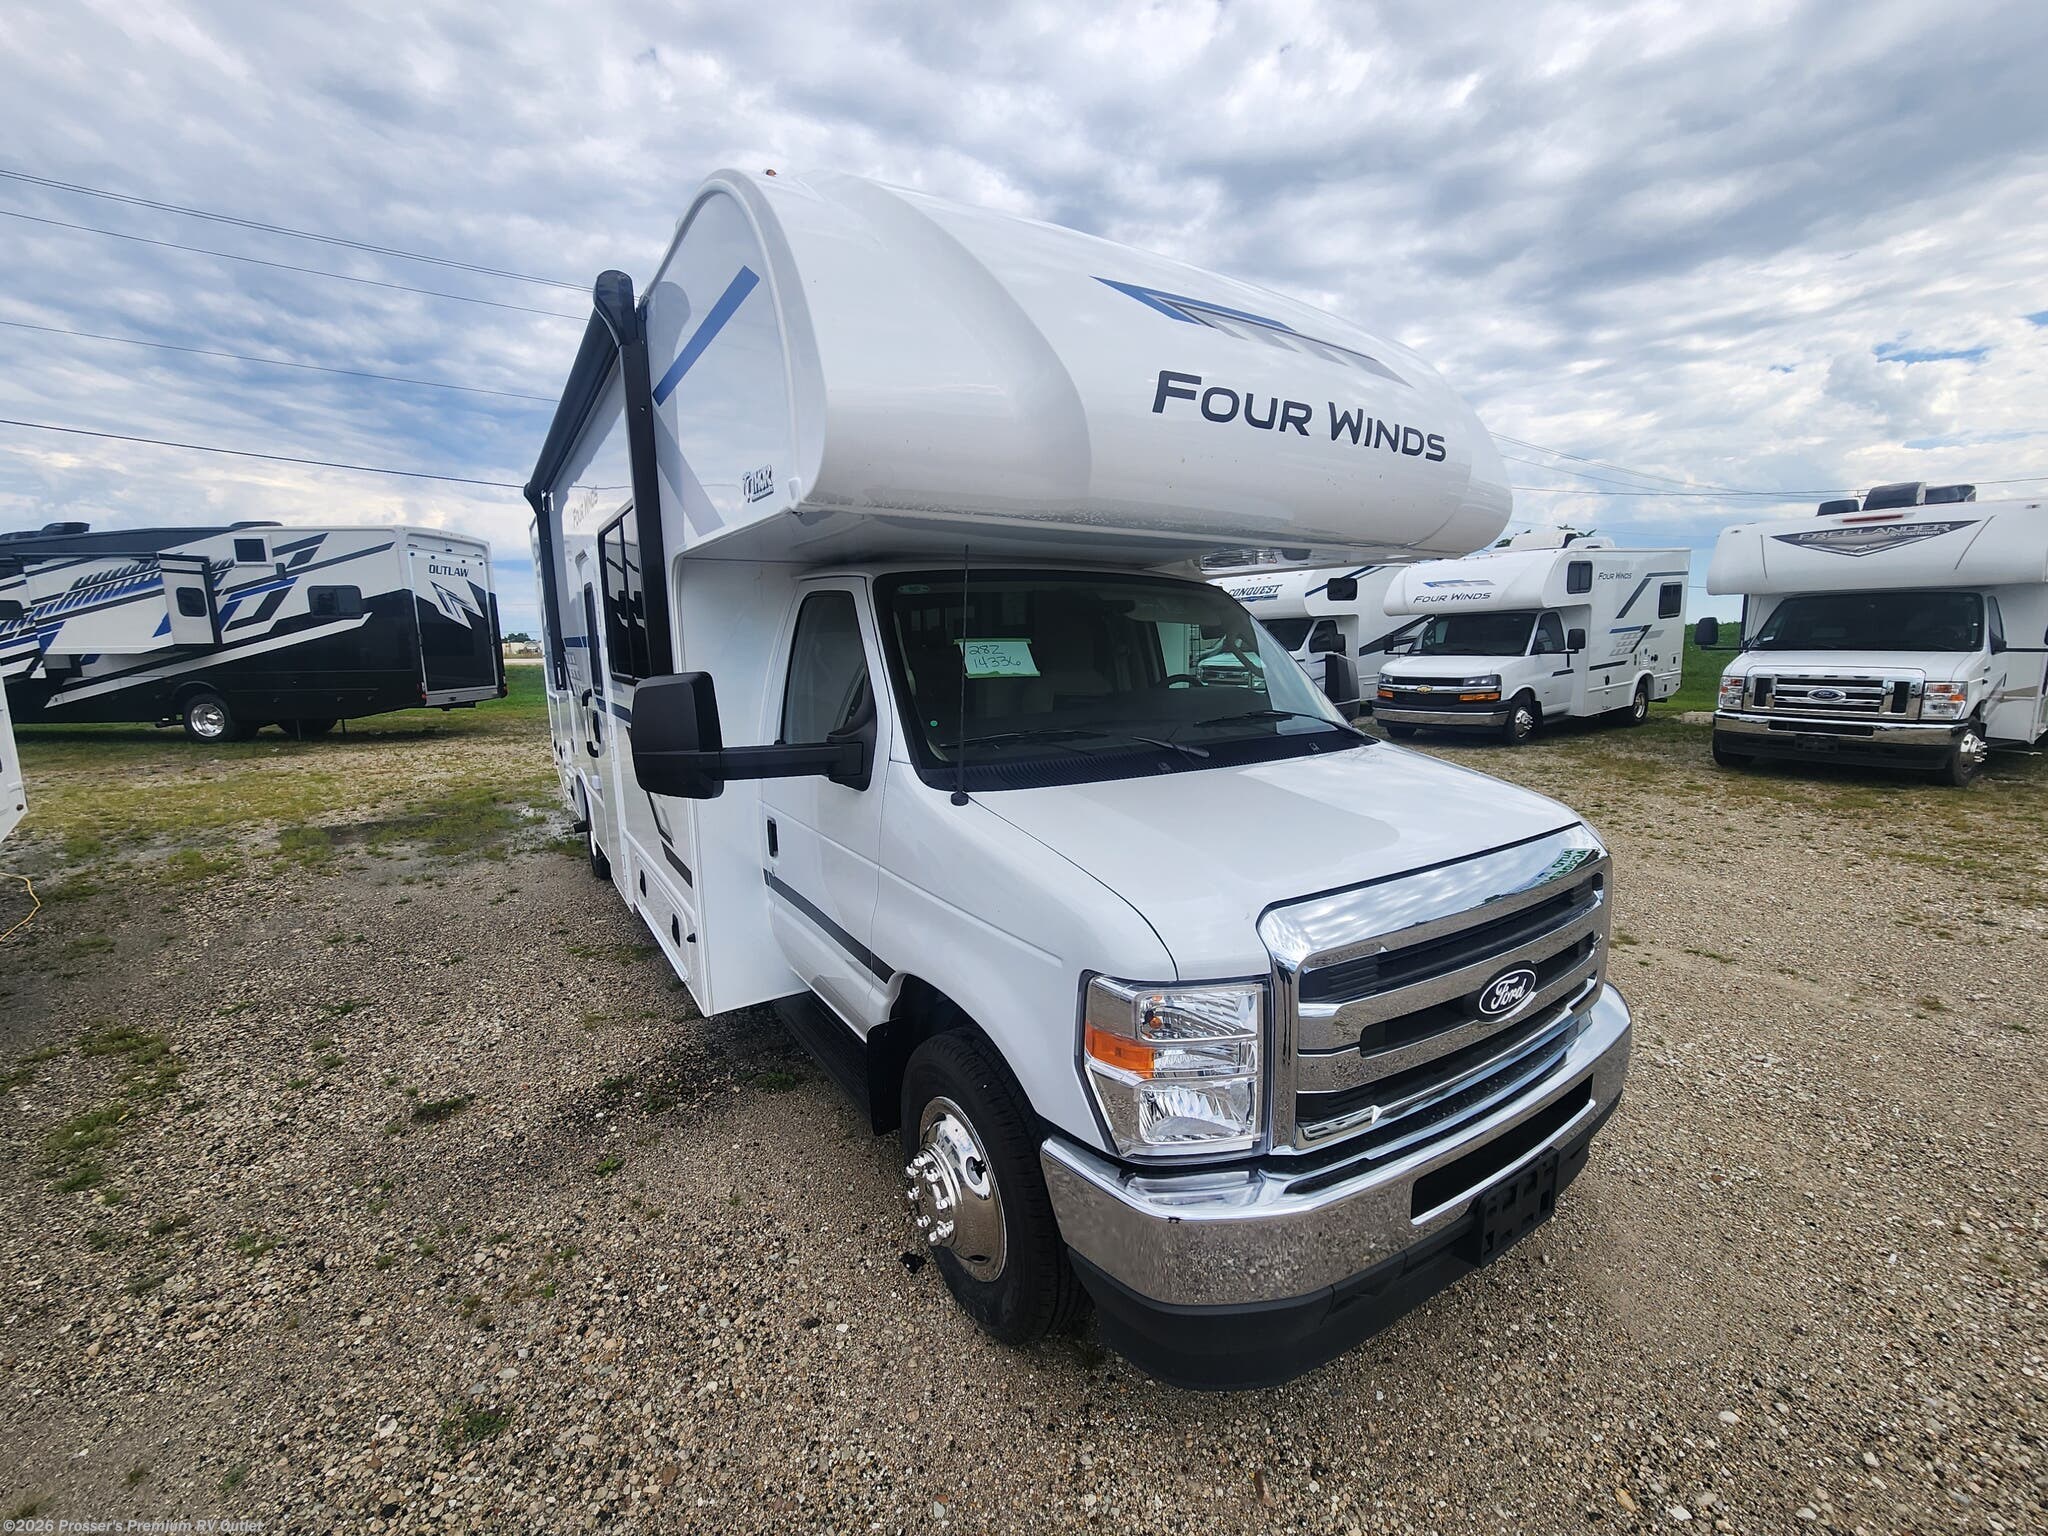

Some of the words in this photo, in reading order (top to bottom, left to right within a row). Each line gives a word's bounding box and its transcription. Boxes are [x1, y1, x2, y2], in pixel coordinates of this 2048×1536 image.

[1152, 370, 1312, 437] FOUR
[1328, 401, 1447, 462] WINDS
[1799, 523, 1951, 541] FREELANDER
[429, 564, 469, 577] OUTLAW
[1598, 572, 1614, 580] FOUR
[1616, 572, 1632, 580] WINDS
[1229, 584, 1283, 597] CONQUEST
[1413, 594, 1447, 604] FOUR
[1450, 592, 1491, 601] WINDS
[973, 656, 1021, 669] 14336
[1491, 976, 1527, 1009] Ford
